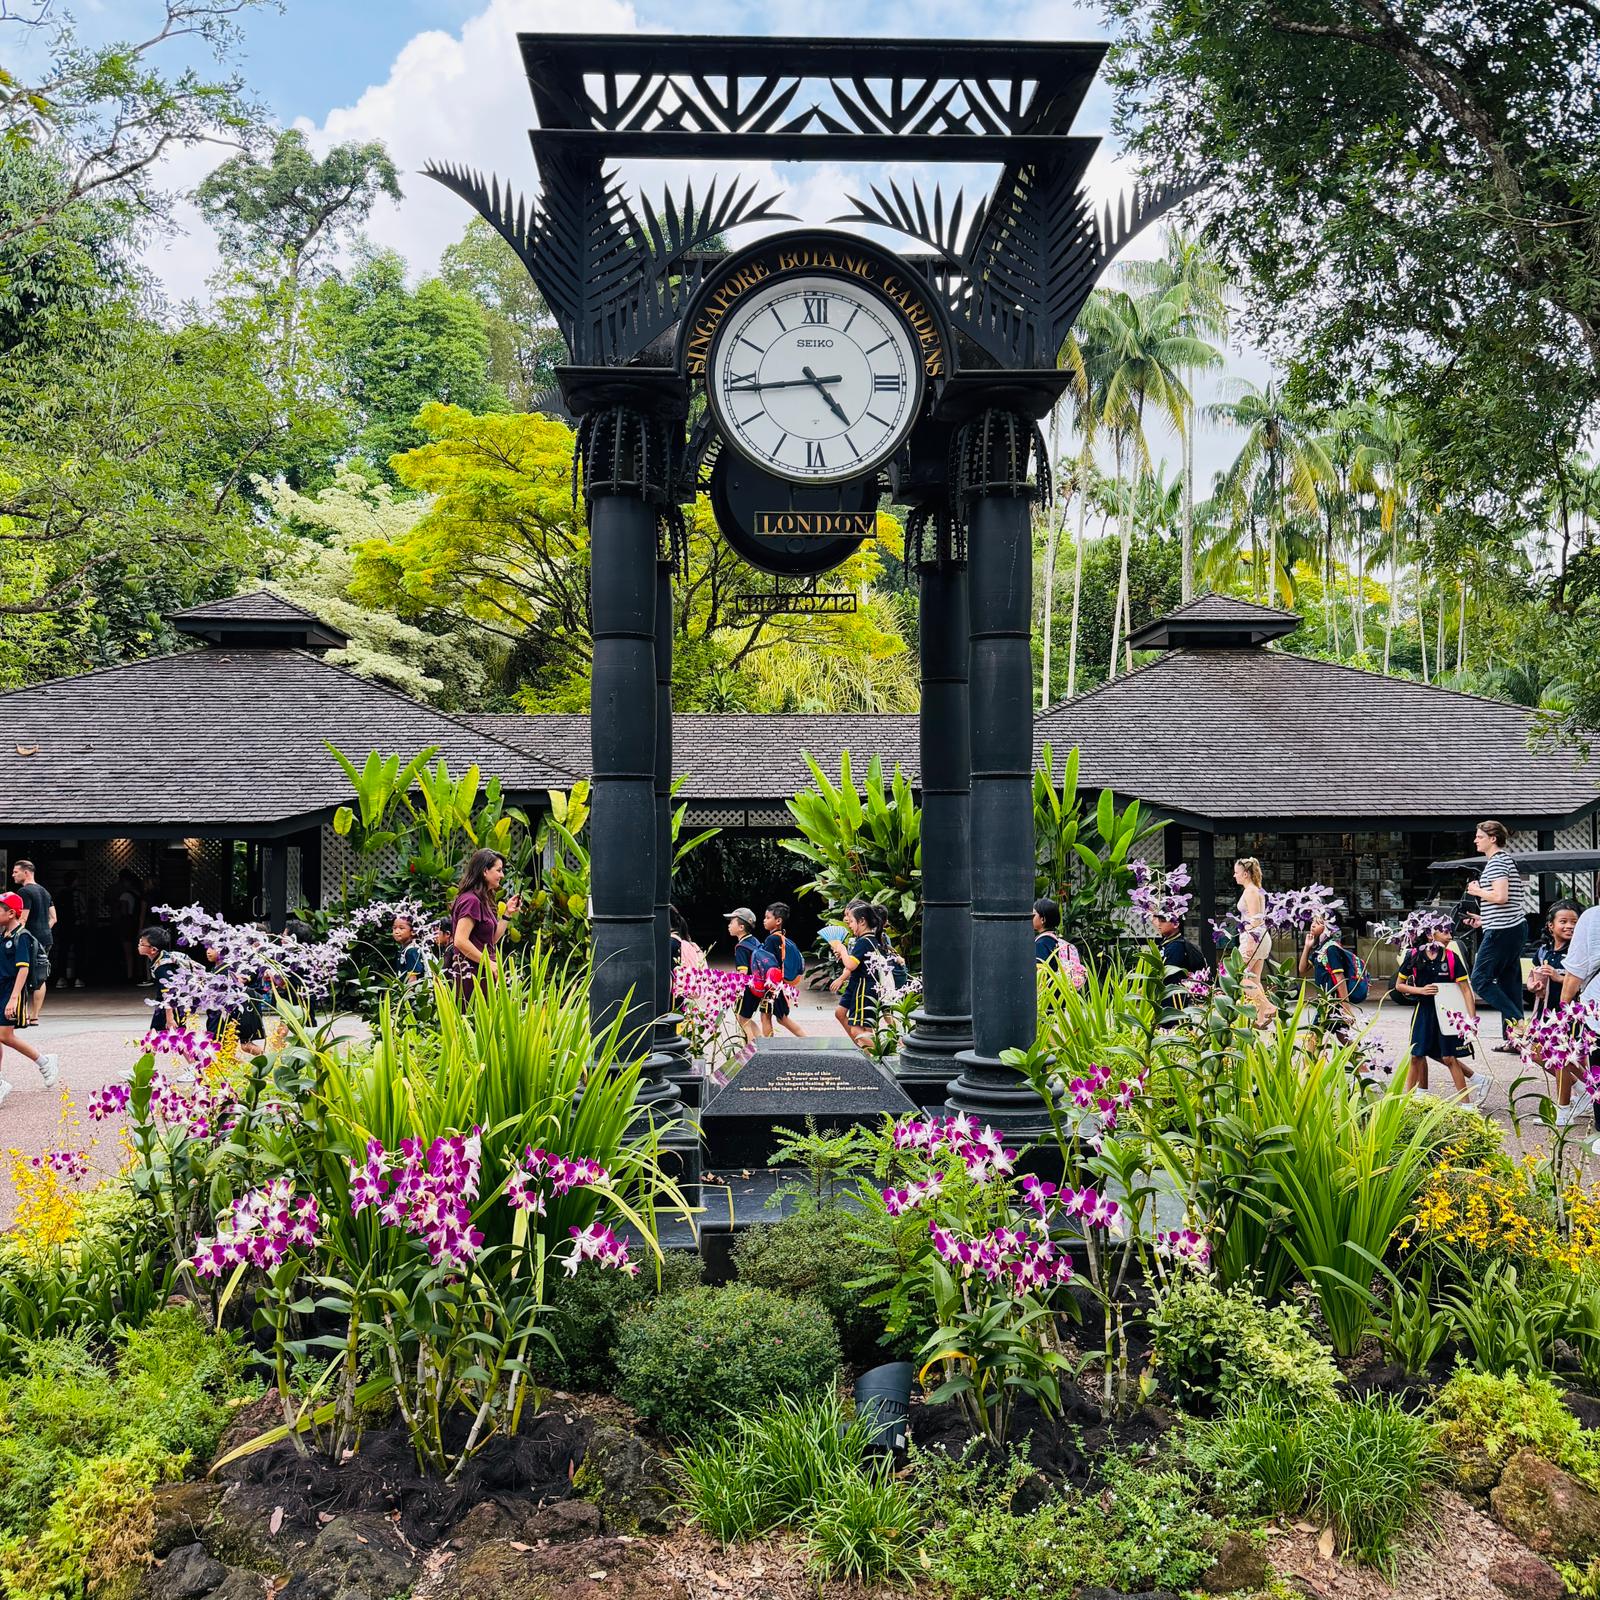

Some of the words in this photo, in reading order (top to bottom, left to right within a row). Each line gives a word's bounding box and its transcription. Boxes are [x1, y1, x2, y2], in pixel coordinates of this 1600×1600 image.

[686, 260, 770, 375] SINGAPORE
[778, 250, 879, 280] BOTANIC
[882, 276, 944, 377] GARDENS
[801, 298, 829, 324] XII
[797, 339, 834, 348] SEIKO
[874, 373, 900, 393] III
[805, 441, 828, 467] VI
[763, 515, 872, 534] LONDON
